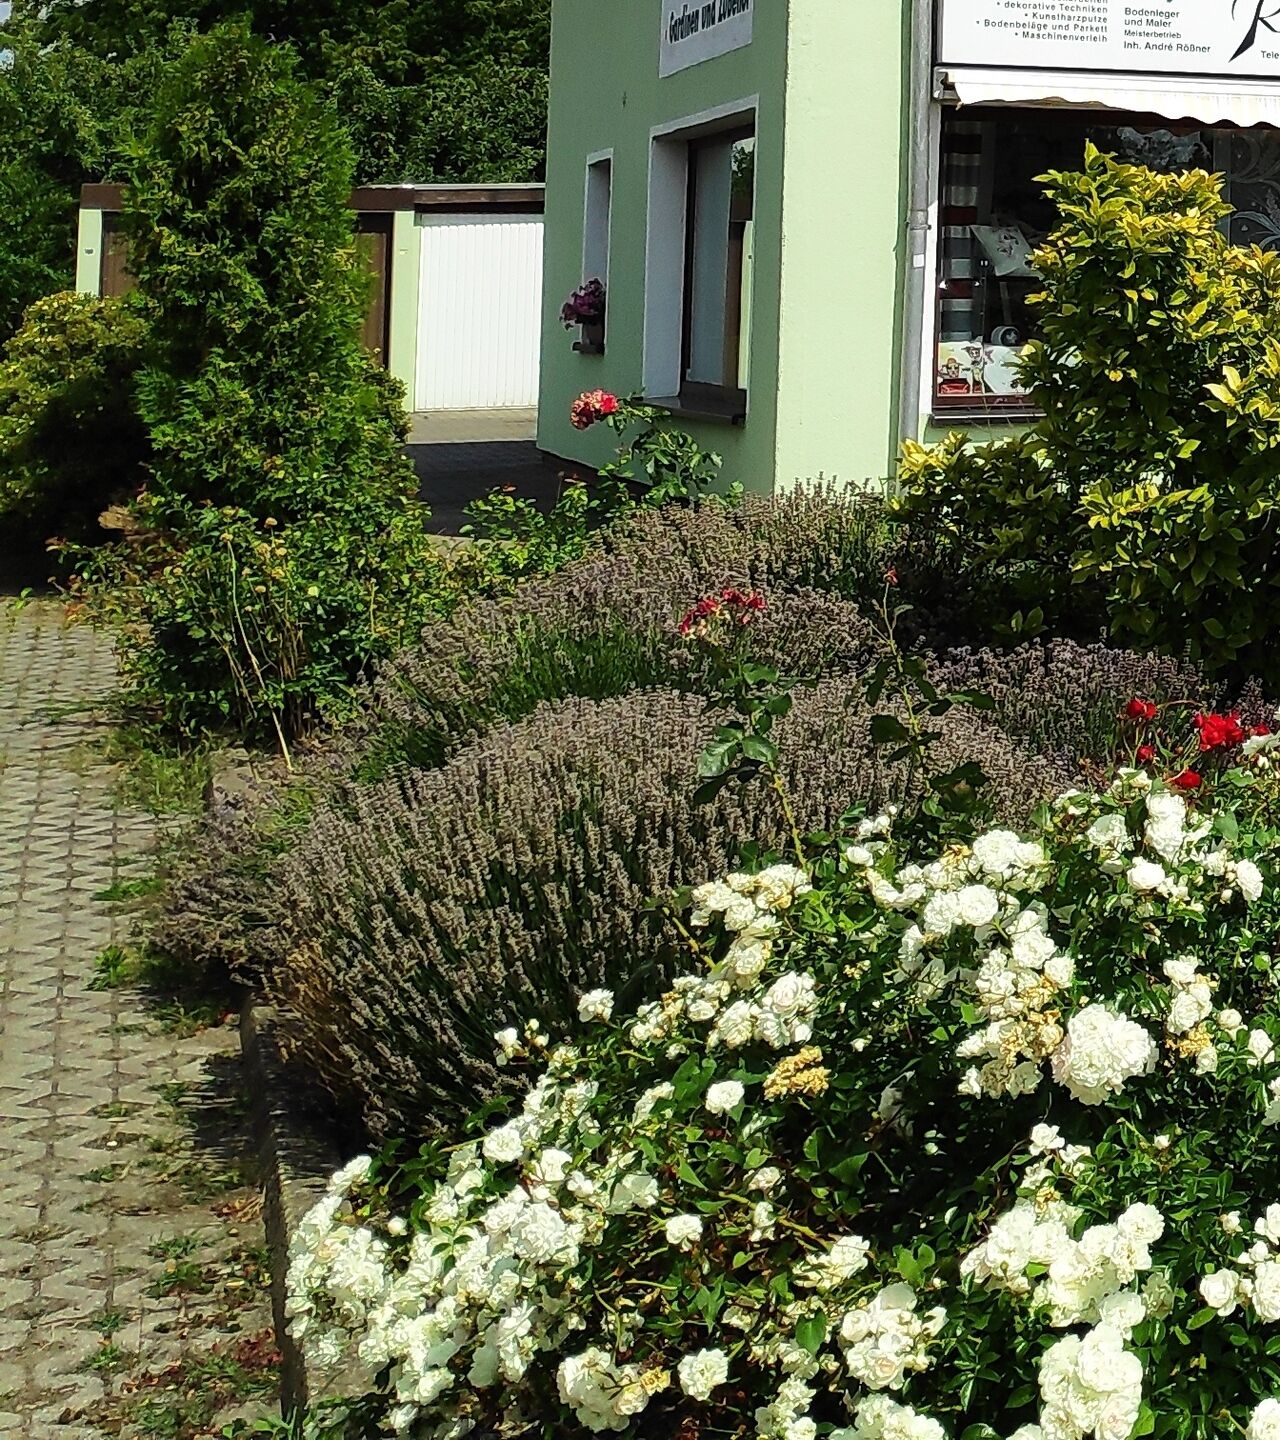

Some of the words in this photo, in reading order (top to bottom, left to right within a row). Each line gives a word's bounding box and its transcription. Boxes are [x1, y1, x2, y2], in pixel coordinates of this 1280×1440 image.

[1004, 1, 1056, 11] dekorative
[1059, 3, 1108, 13] Techniken
[1032, 12, 1108, 23] Kunstharzputze
[1124, 7, 1180, 19] Bodenleger
[984, 19, 1048, 31] Bodenbeläge
[1052, 23, 1070, 31] und
[1073, 24, 1108, 33] Parkett
[1124, 18, 1143, 26] und
[1146, 19, 1172, 27] Maler
[1022, 31, 1108, 42] Maschinenverleih
[1124, 29, 1181, 39] Meisterbetrieb
[1124, 41, 1142, 50] Inh.
[1144, 41, 1173, 51] André
[1176, 43, 1211, 53] Rößner
